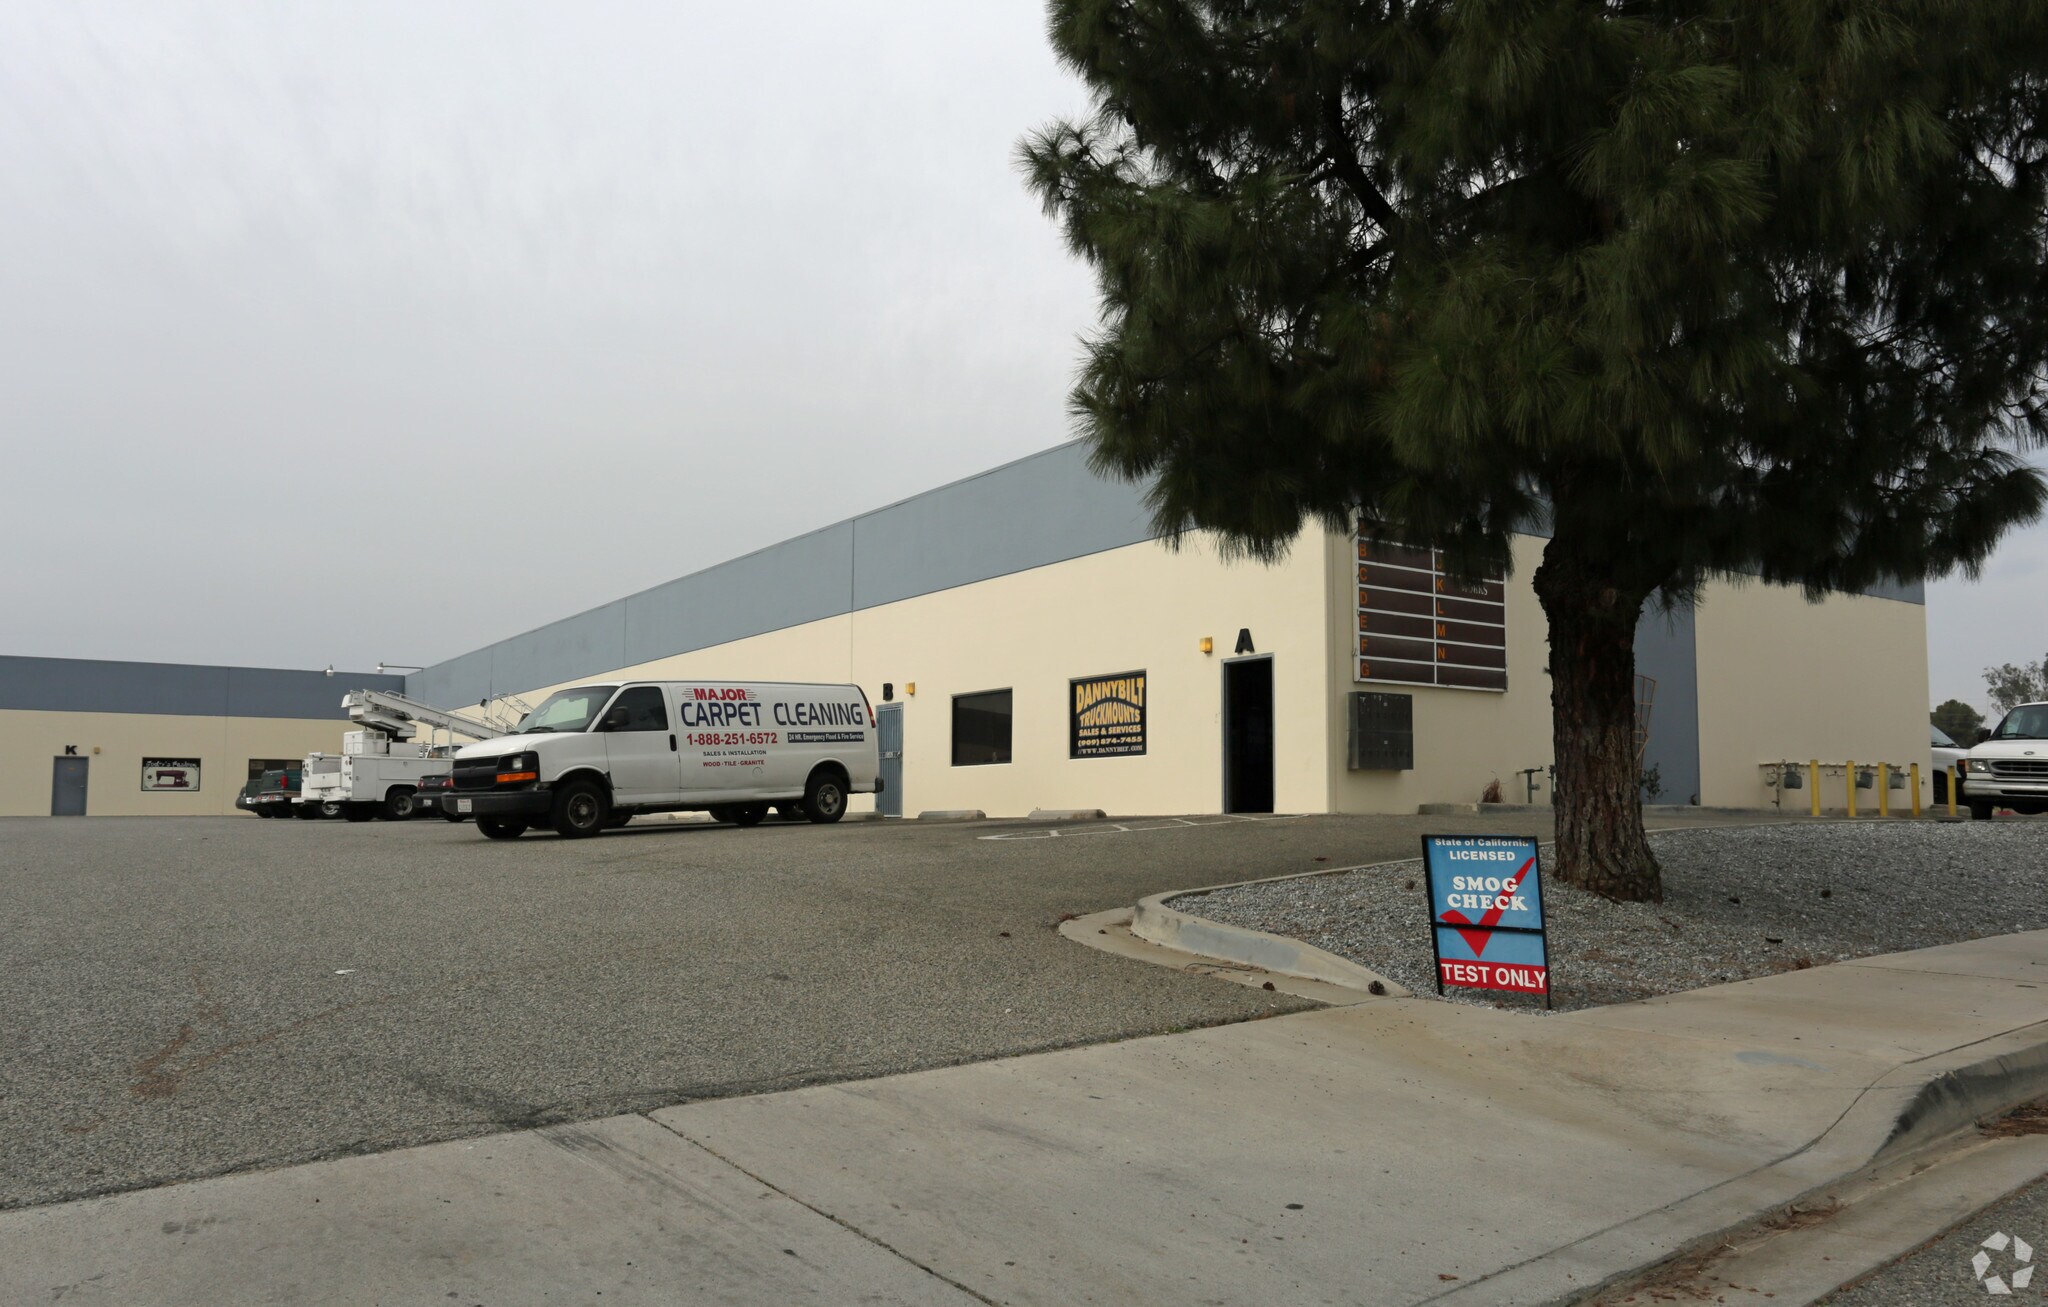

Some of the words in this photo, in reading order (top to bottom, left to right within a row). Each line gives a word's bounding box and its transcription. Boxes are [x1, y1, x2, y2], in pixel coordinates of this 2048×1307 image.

[1359, 544, 1367, 556] B
[1359, 567, 1367, 581] C
[1436, 578, 1444, 592] K
[1360, 591, 1368, 604] D
[1437, 601, 1444, 614] L
[1360, 615, 1368, 628] E
[1437, 624, 1446, 637] M
[1235, 628, 1254, 653] A
[1360, 639, 1368, 652] F
[1438, 647, 1446, 660] N
[1361, 662, 1370, 676] G
[693, 688, 747, 701] MAJOR
[882, 682, 894, 700] B
[1076, 677, 1144, 714] DANNYBILT
[681, 702, 761, 727] CARPET
[774, 703, 863, 725] CLEANING
[1080, 701, 1140, 727] TRUCKMOUNTS
[1079, 728, 1099, 736] SALES
[1100, 727, 1107, 735] &
[1108, 725, 1141, 734] SERVICES
[687, 732, 778, 745] 1-888-251-6572
[803, 734, 825, 742] Emergency
[1078, 738, 1099, 747] (909)
[1101, 736, 1142, 745] 874-7455
[65, 745, 78, 755] K
[1478, 839, 1529, 847] California
[1450, 851, 1515, 861] LICENSED
[1452, 876, 1518, 892] SMOG
[1447, 894, 1528, 911] CHECK
[1441, 963, 1490, 983] TEST
[1496, 968, 1546, 988] ONLY
